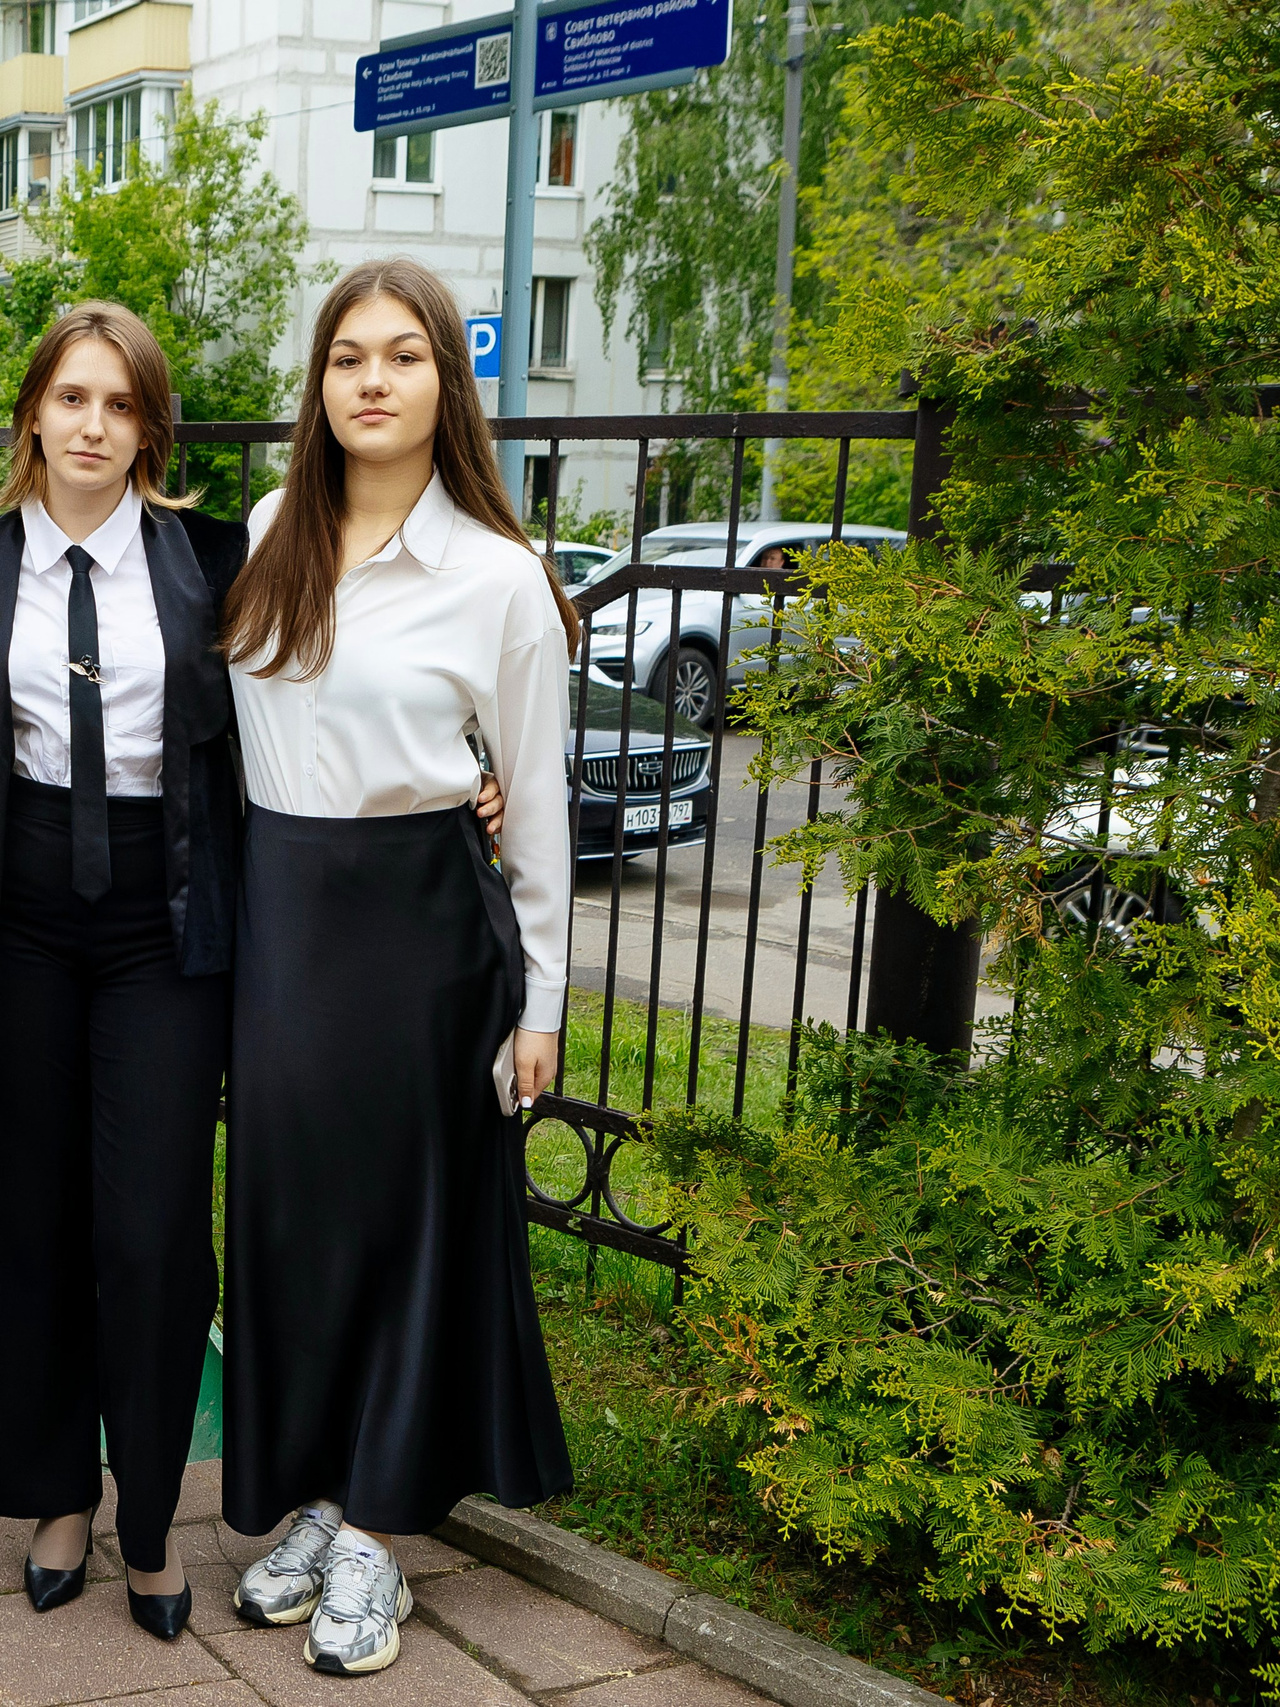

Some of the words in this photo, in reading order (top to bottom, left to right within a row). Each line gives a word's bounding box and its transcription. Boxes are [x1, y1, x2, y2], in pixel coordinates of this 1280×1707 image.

[564, 17, 595, 35] Совет
[596, 4, 653, 27] ветеранов
[564, 29, 615, 51] Свиблово
[469, 323, 496, 375] P
[673, 803, 689, 818] 797
